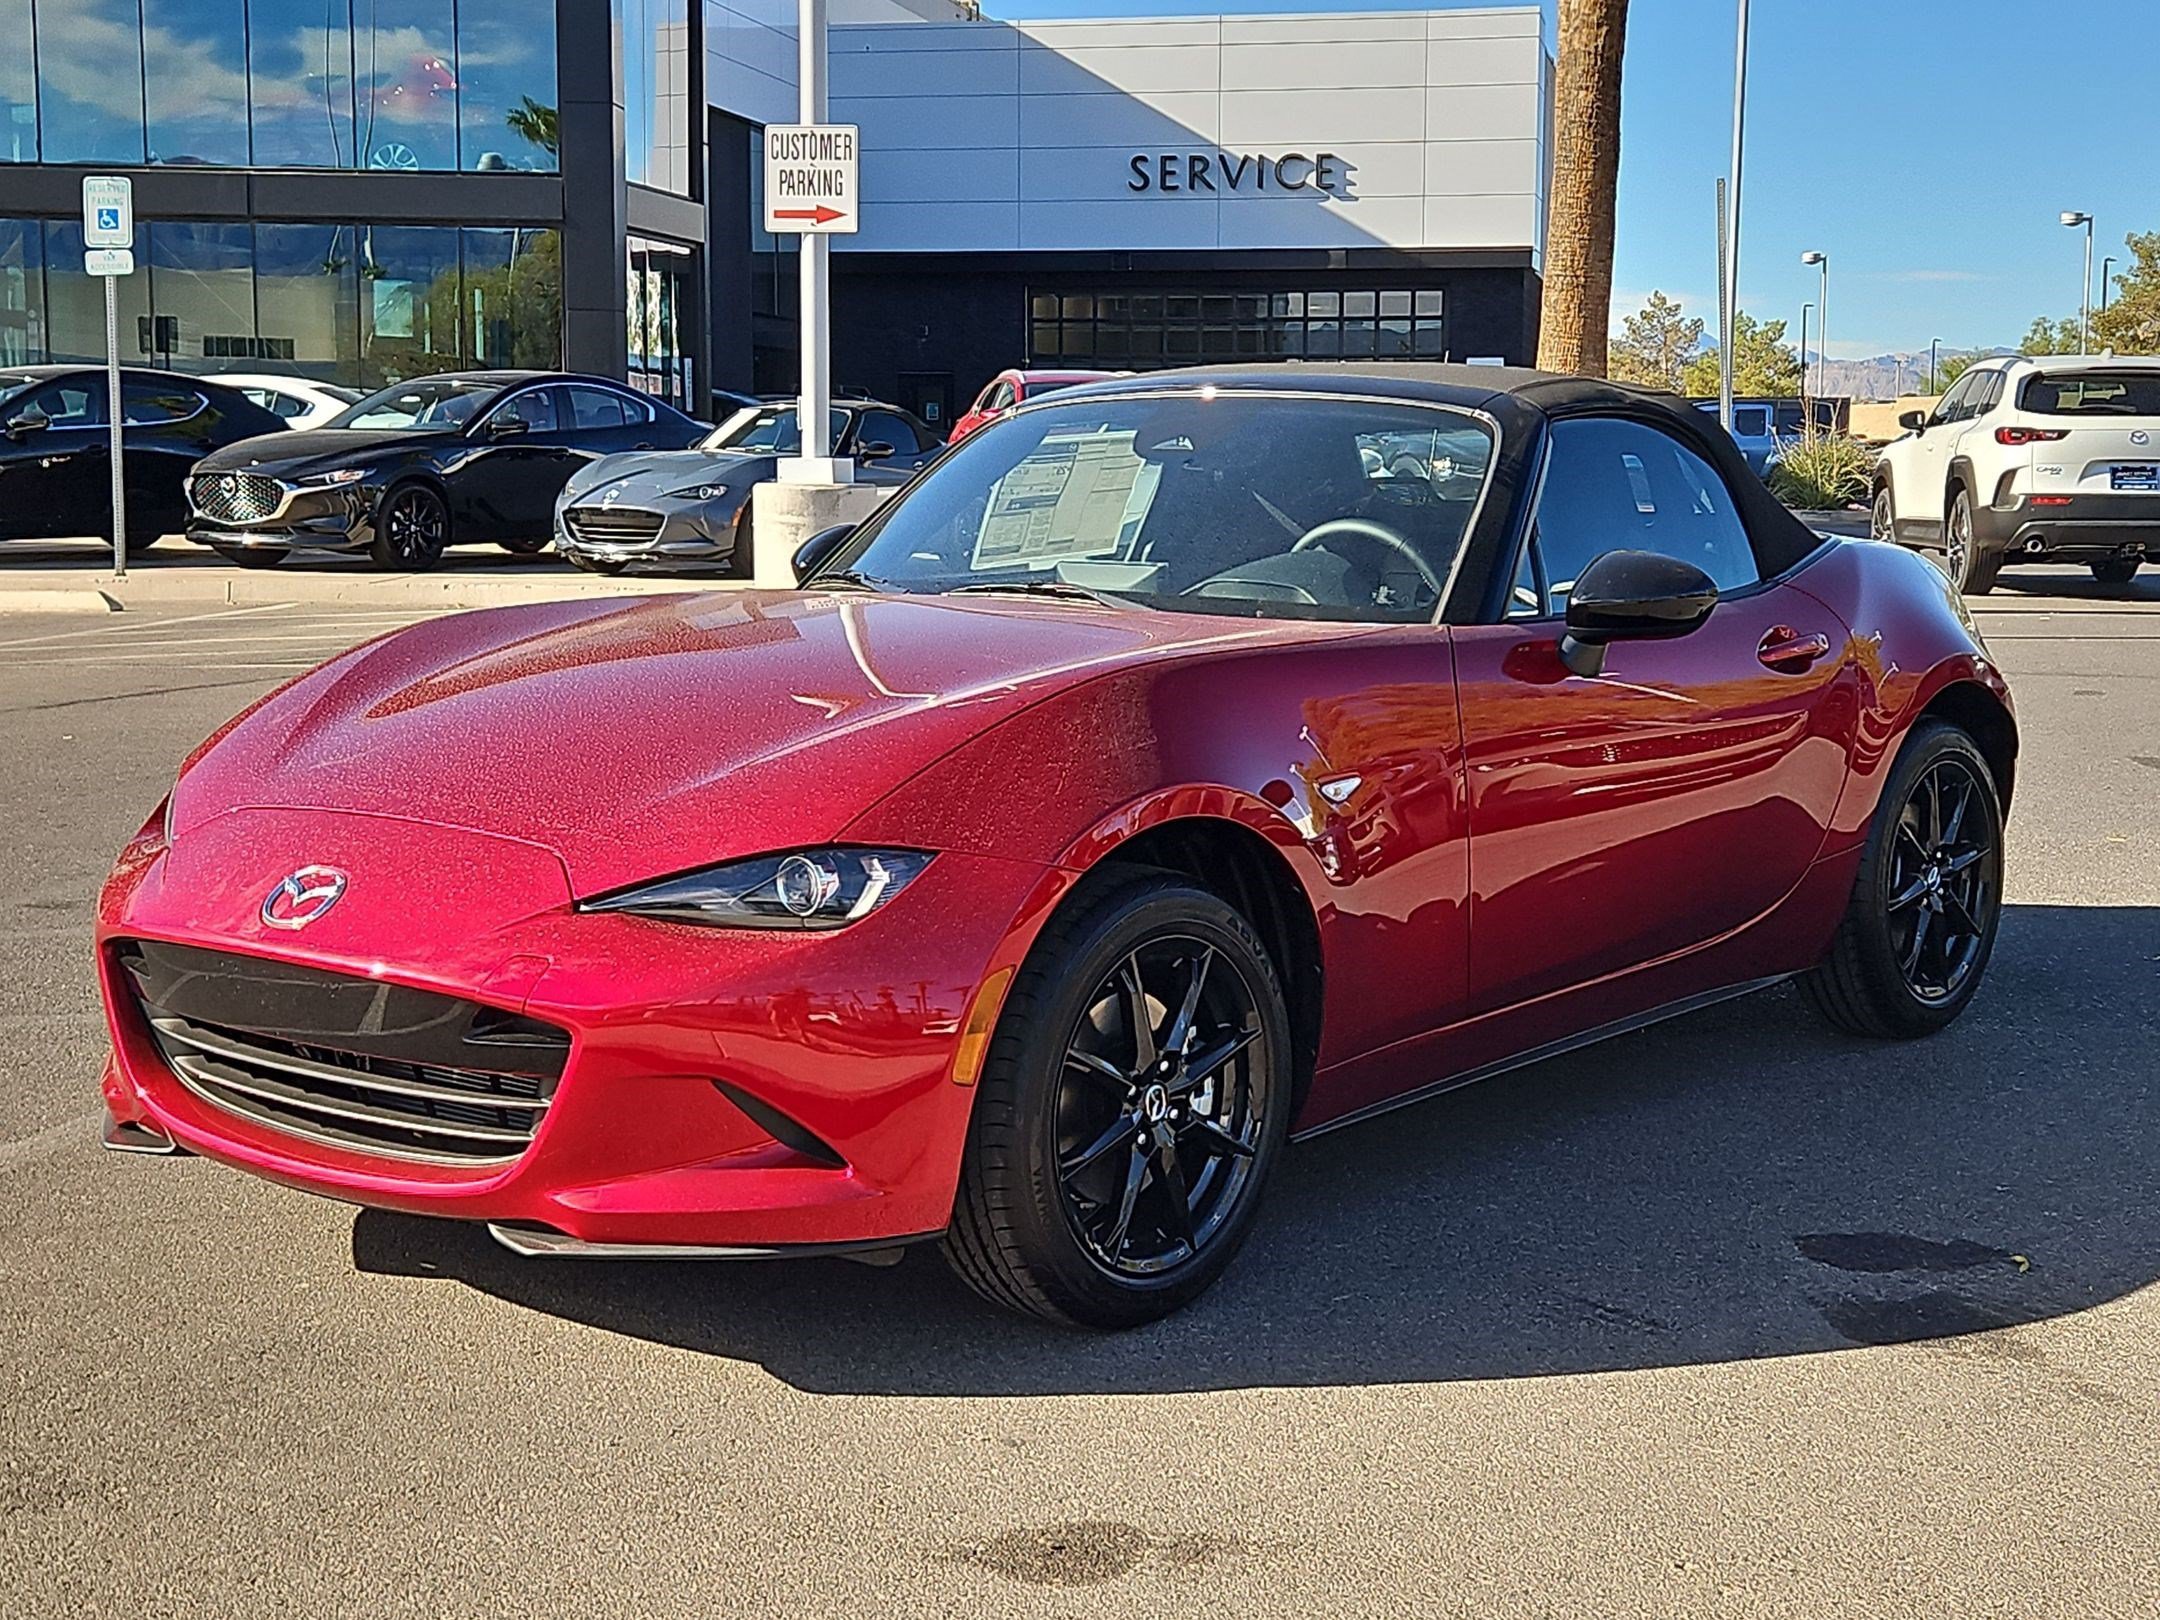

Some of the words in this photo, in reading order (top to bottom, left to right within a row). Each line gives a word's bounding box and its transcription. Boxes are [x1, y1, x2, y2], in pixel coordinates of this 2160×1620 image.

[770, 132, 853, 161] CUSTOMER
[779, 169, 843, 197] PARKING
[1127, 153, 1337, 192] SERVICE
